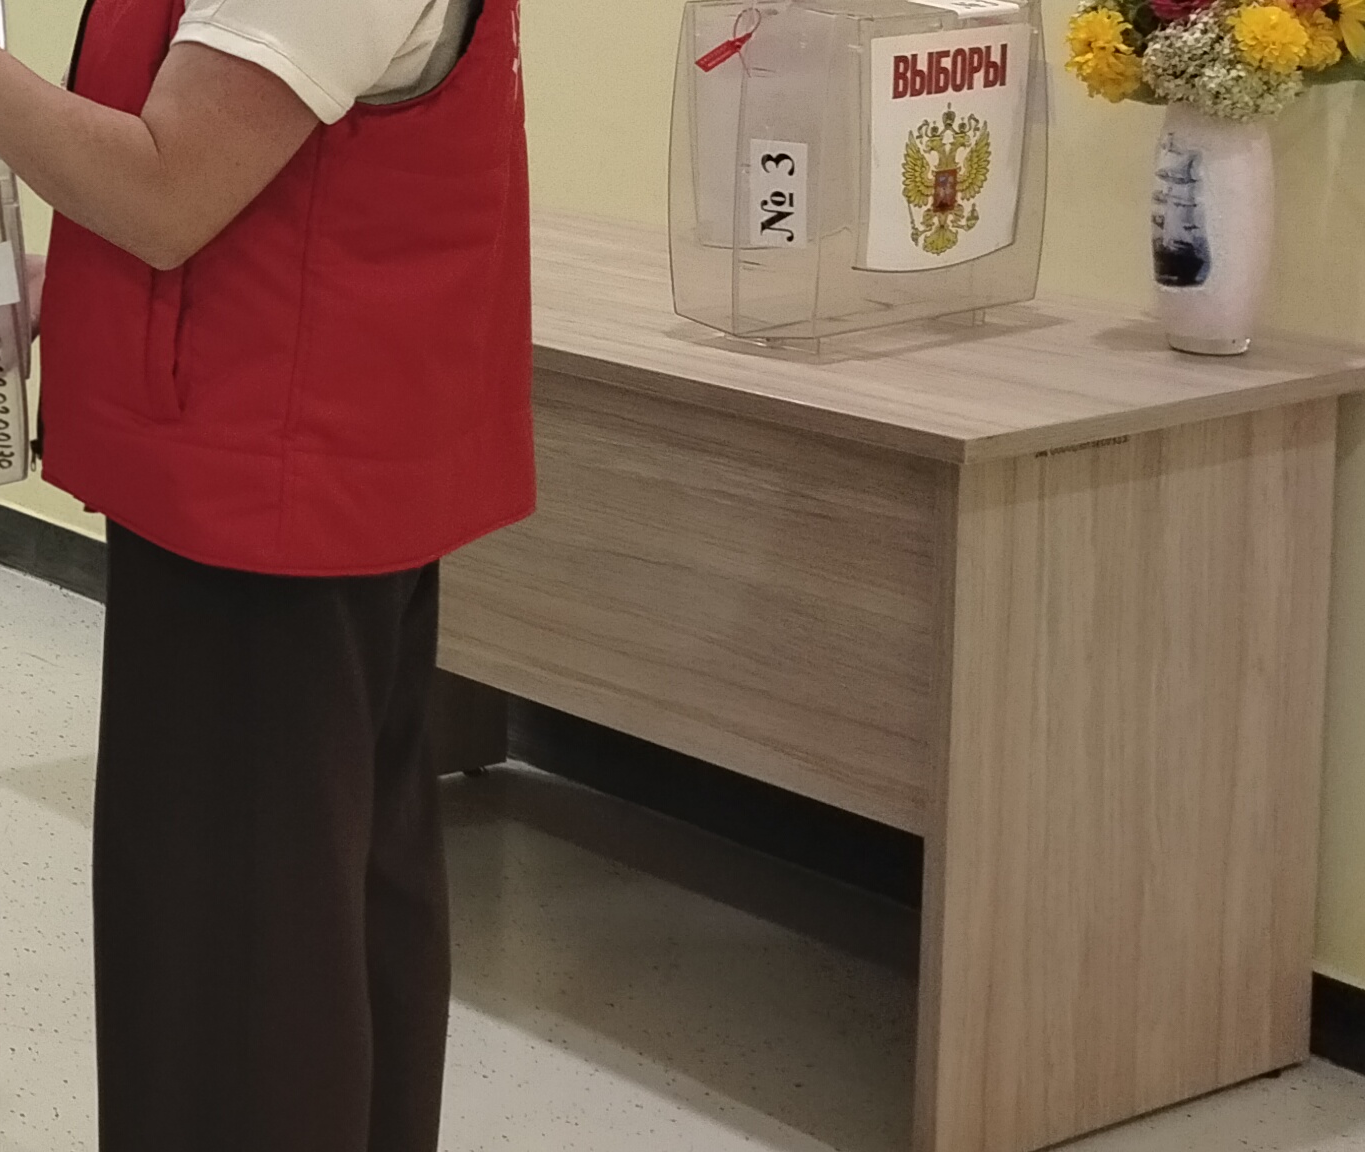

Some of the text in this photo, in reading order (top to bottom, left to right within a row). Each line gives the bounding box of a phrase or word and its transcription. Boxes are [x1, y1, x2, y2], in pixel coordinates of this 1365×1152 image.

[892, 43, 1009, 100] ВЫБОРЫ
[760, 152, 795, 242] № 3
